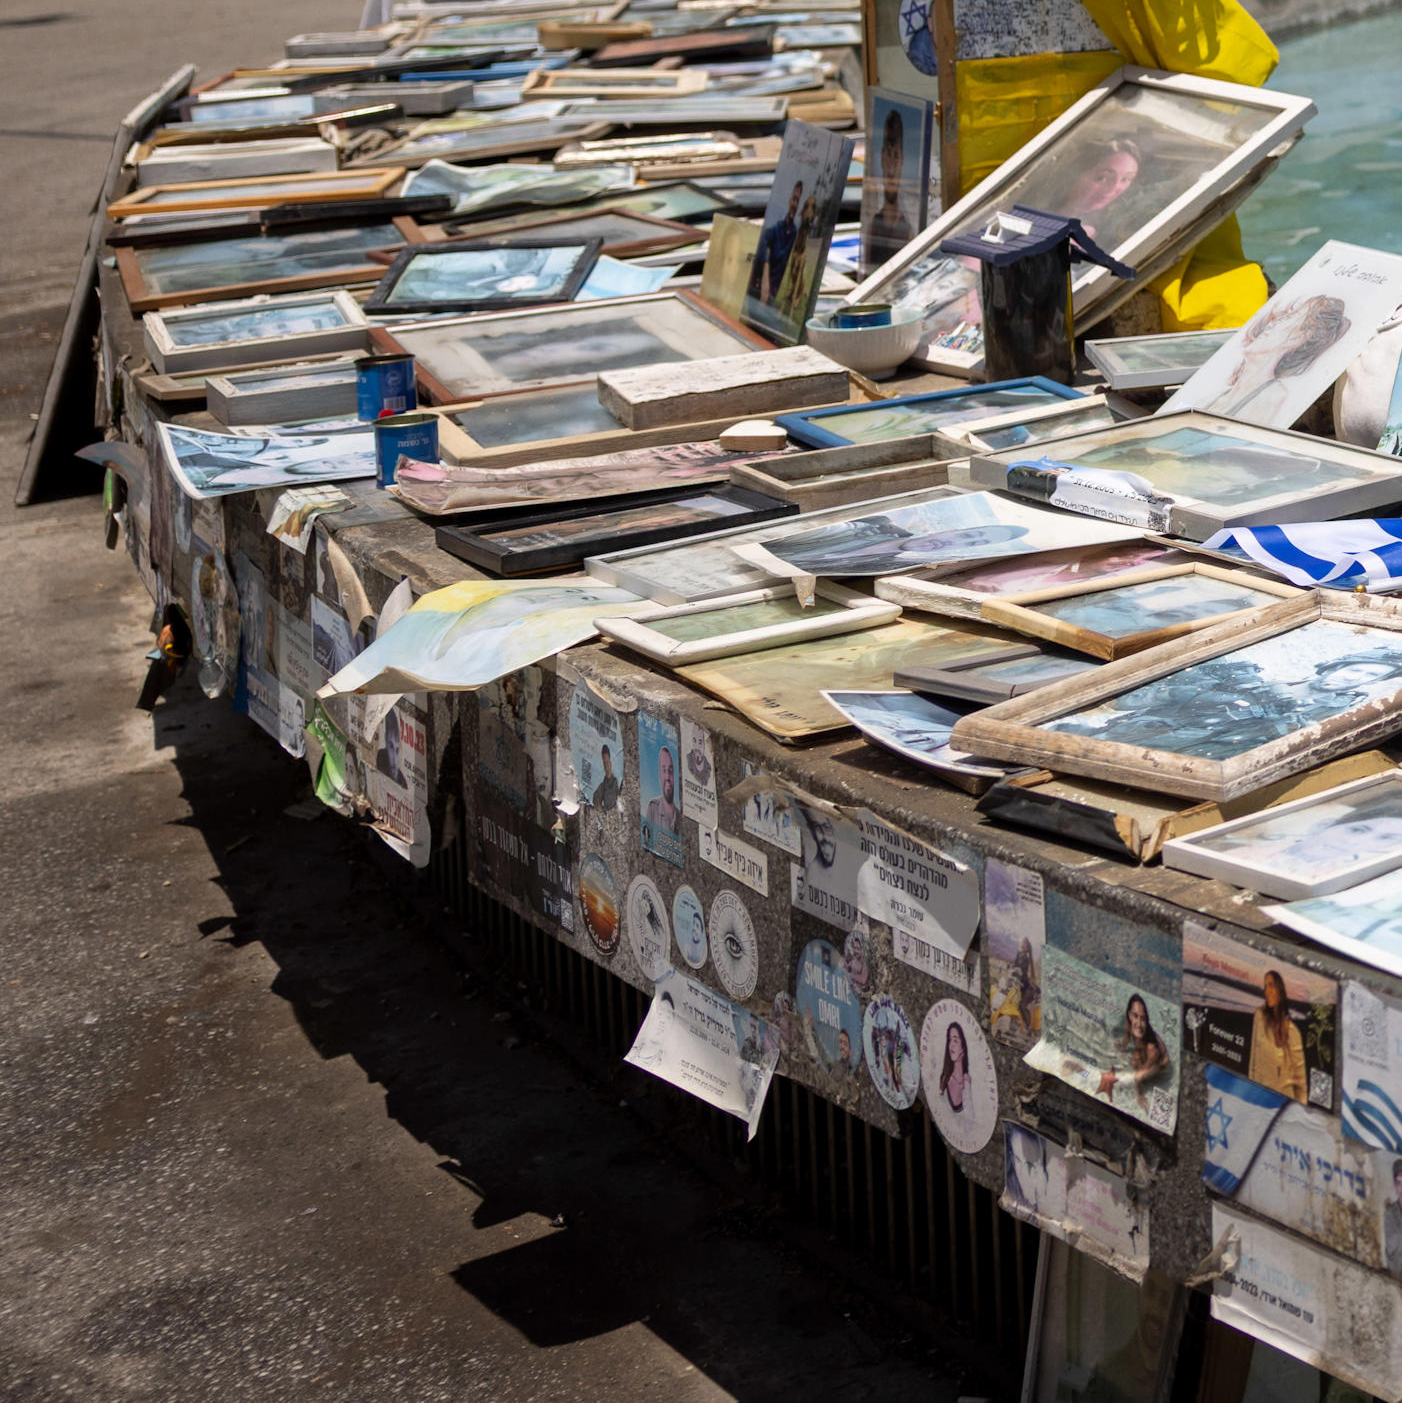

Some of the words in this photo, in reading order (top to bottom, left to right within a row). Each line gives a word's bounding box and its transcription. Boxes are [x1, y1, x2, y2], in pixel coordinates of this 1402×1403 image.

[860, 838, 877, 858] הזה
[880, 844, 906, 869] בעולם
[907, 857, 949, 889] מהדהדים
[907, 878, 930, 901] לנצח
[803, 961, 830, 995] SMILE
[831, 974, 852, 1006] LIKE
[818, 999, 841, 1030] OMRI
[1208, 1023, 1234, 1040] Forever
[1235, 1036, 1245, 1046] 22
[1274, 1136, 1312, 1174] איתי
[1316, 1156, 1367, 1199] בדרכי
